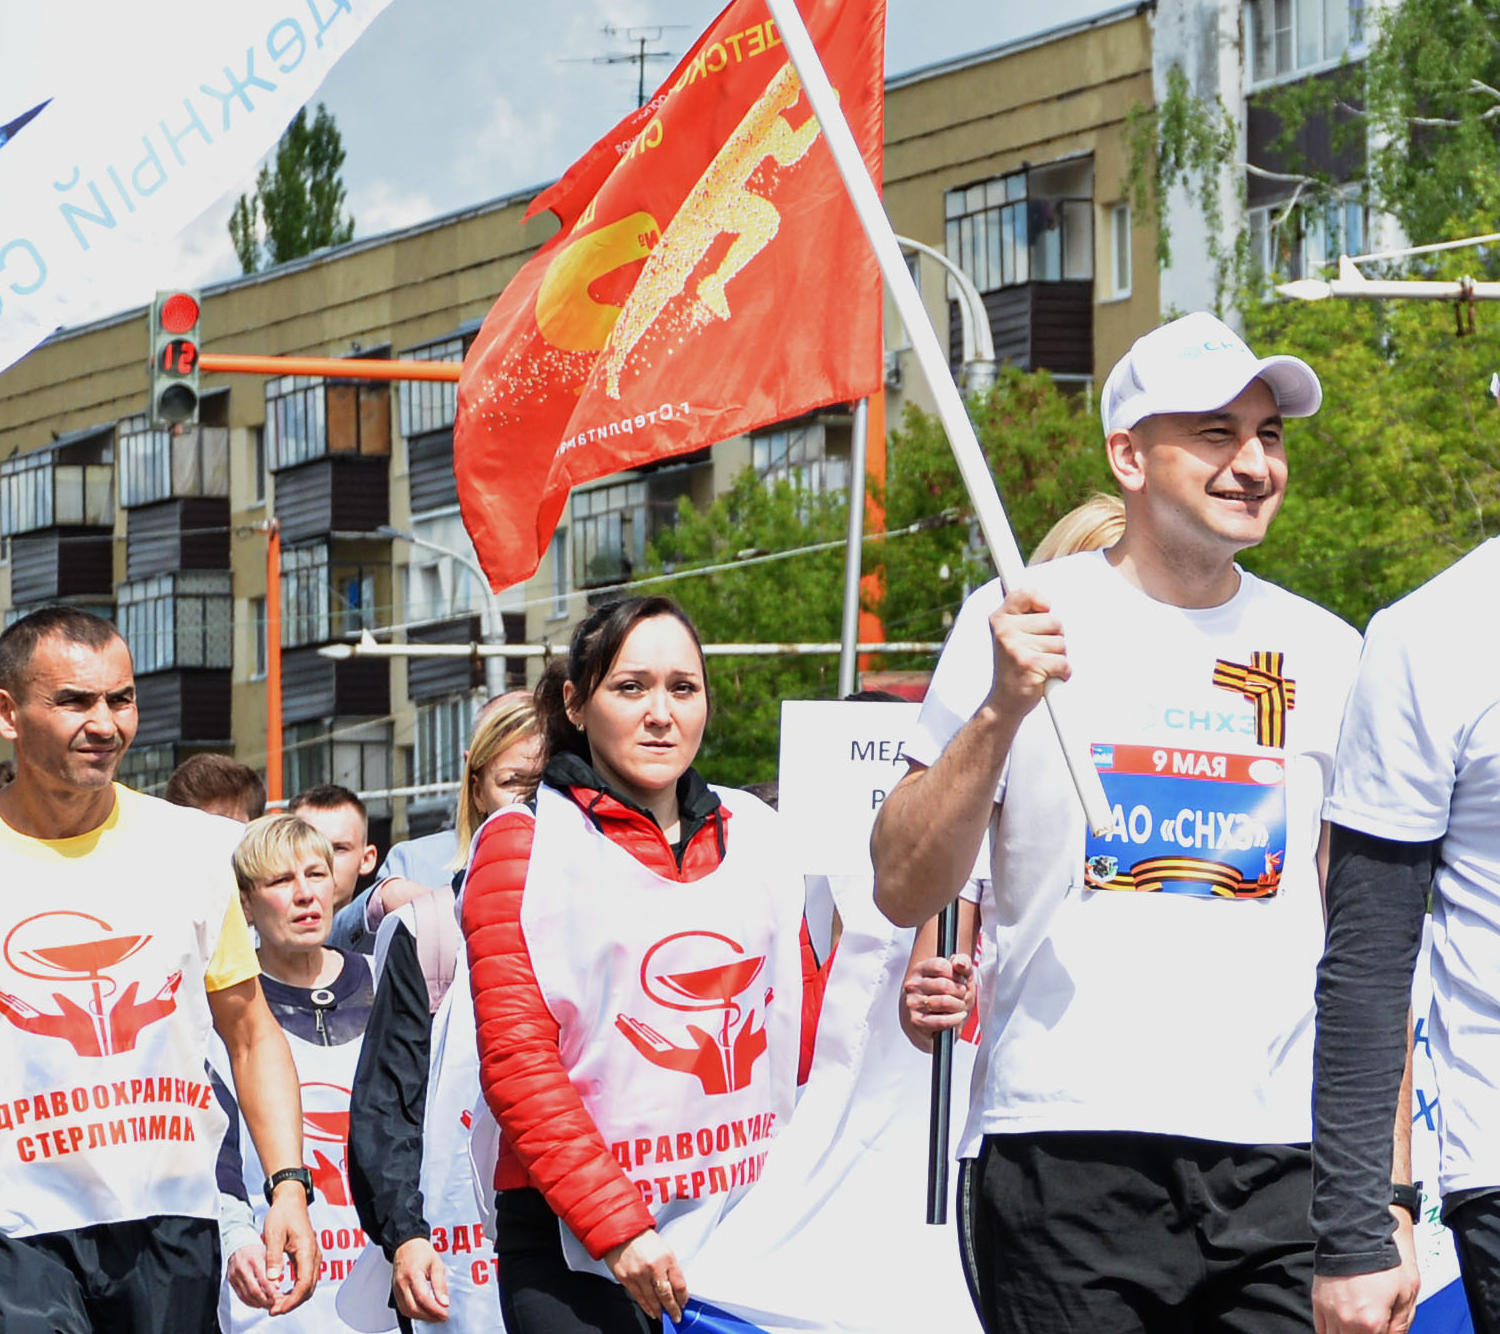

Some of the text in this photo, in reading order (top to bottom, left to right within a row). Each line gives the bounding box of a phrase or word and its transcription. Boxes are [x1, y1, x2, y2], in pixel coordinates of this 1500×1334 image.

[1152, 750, 1228, 778] 9 МАЯ
[1104, 803, 1270, 852] АО «СНХЗ»
